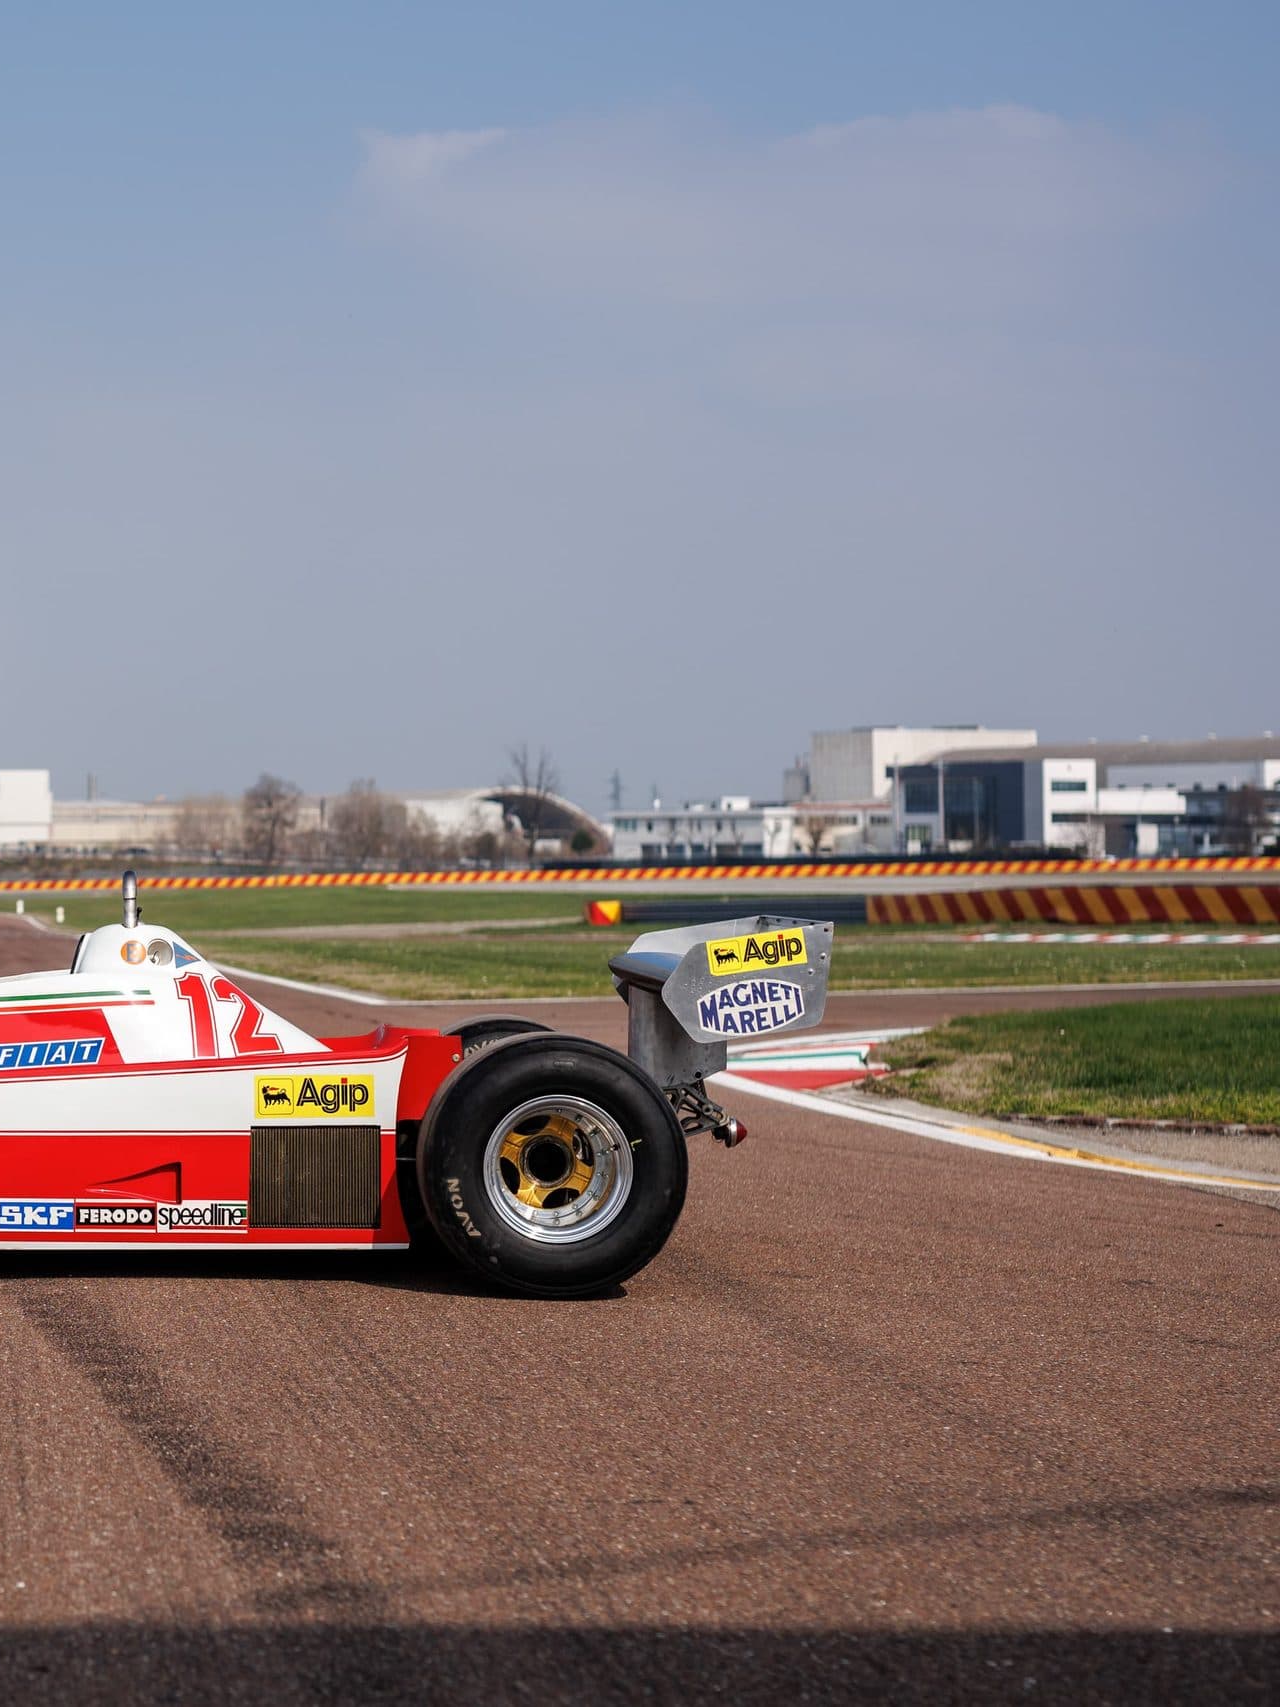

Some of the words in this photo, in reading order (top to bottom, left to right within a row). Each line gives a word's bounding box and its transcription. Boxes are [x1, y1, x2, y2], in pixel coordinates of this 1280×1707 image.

[744, 934, 802, 965] Agip
[699, 982, 802, 1014] MAGNETI
[174, 972, 284, 1058] 12
[700, 1000, 802, 1034] MARELLI
[296, 1077, 369, 1114] Agip
[0, 1205, 74, 1226] SKF
[79, 1207, 154, 1224] FERODO
[158, 1203, 243, 1230] speedline
[447, 1178, 482, 1237] AVON
